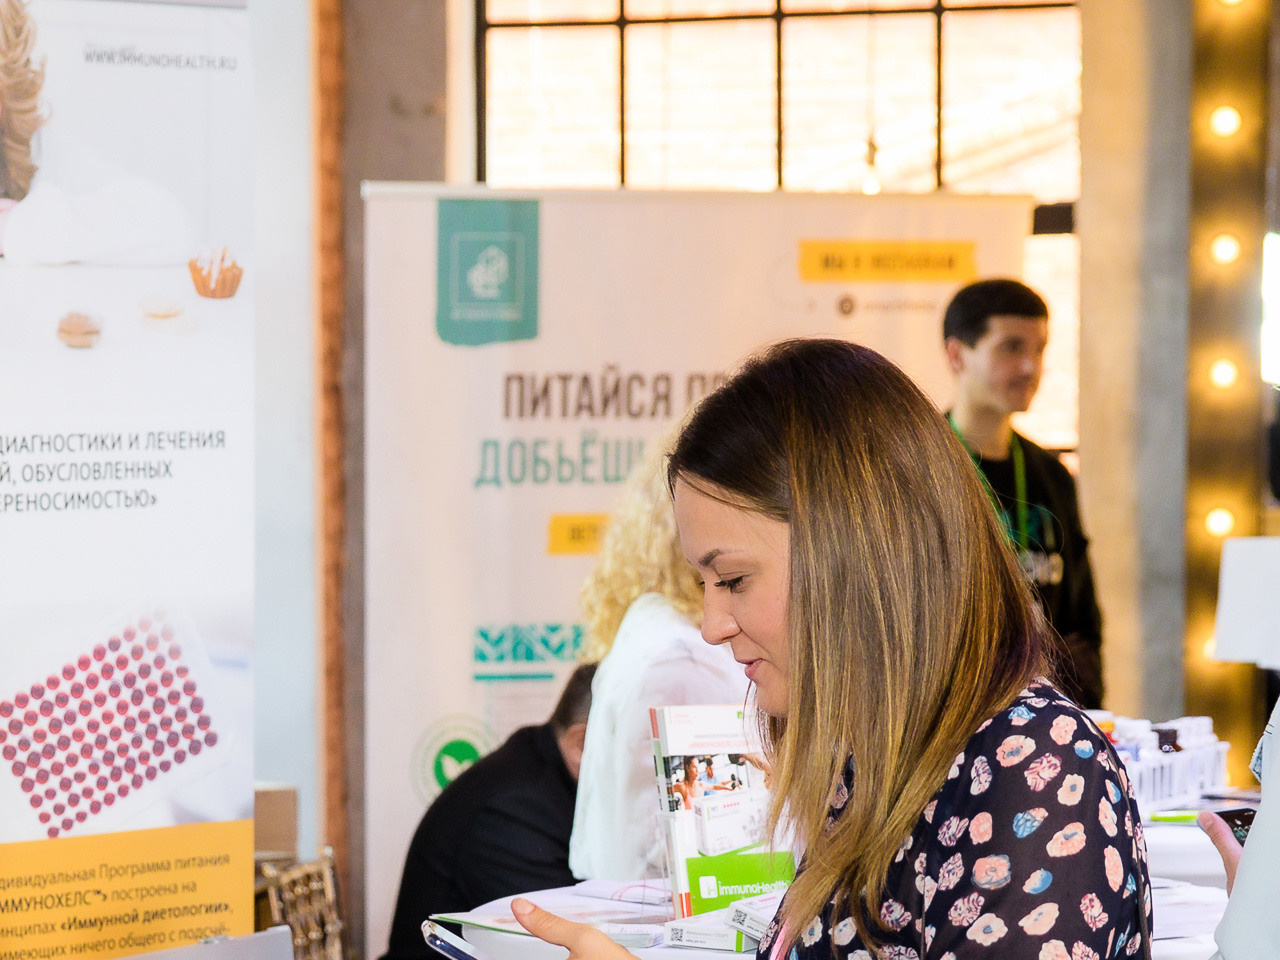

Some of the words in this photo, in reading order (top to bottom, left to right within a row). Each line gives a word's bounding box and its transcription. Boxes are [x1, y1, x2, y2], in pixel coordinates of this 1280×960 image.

[503, 364, 673, 419] ПИТАЙСЯ
[128, 431, 140, 450] И
[145, 430, 226, 450] ЛЕЧЕНИЯ
[21, 460, 173, 483] ОБУСЛОВЛЕННЫХ
[98, 860, 171, 882] Программа
[174, 853, 230, 870] питания
[110, 883, 178, 904] построена
[181, 881, 197, 894] на
[70, 935, 117, 955] ничего
[119, 930, 167, 949] общего
